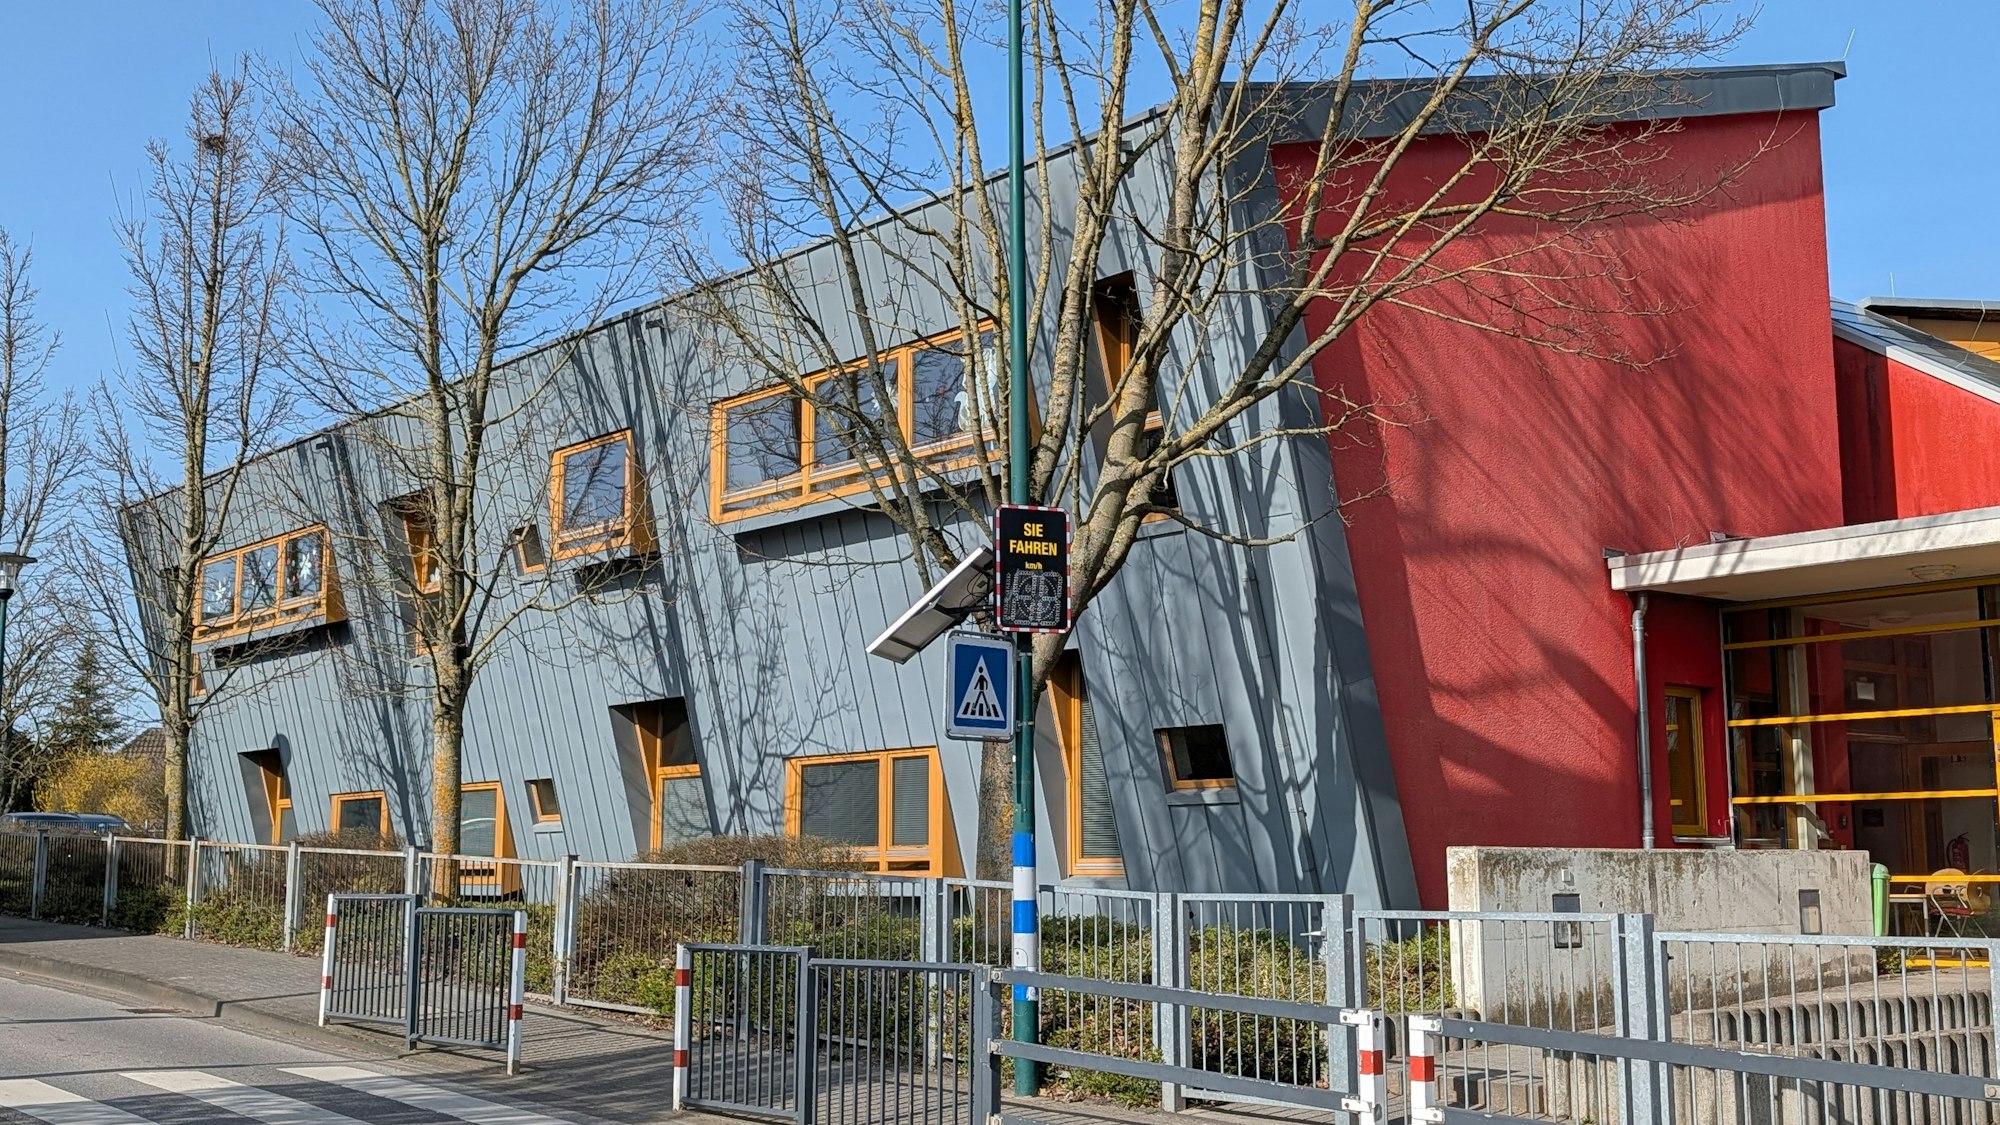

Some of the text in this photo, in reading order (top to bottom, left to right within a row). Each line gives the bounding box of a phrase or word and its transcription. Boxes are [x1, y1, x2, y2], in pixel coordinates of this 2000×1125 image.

[1023, 522, 1044, 537] SIE
[1009, 539, 1058, 556] FAHREN
[1025, 561, 1043, 570] km/h
